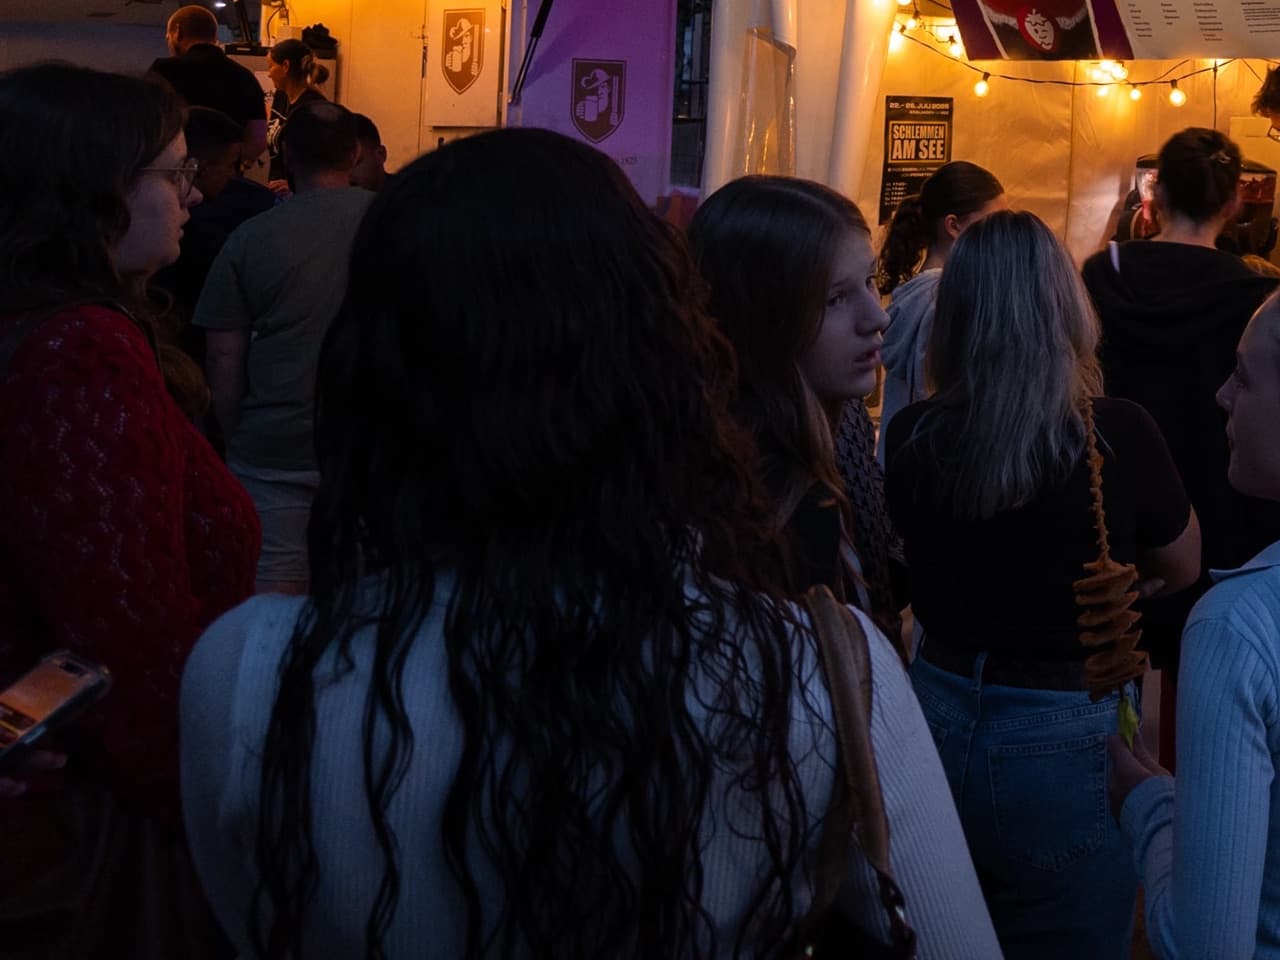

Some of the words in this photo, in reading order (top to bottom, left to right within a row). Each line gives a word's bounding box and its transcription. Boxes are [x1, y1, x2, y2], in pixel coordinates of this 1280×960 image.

[893, 125, 944, 139] SCHLEMMEN
[892, 140, 916, 160] AM
[918, 140, 944, 159] SEE
